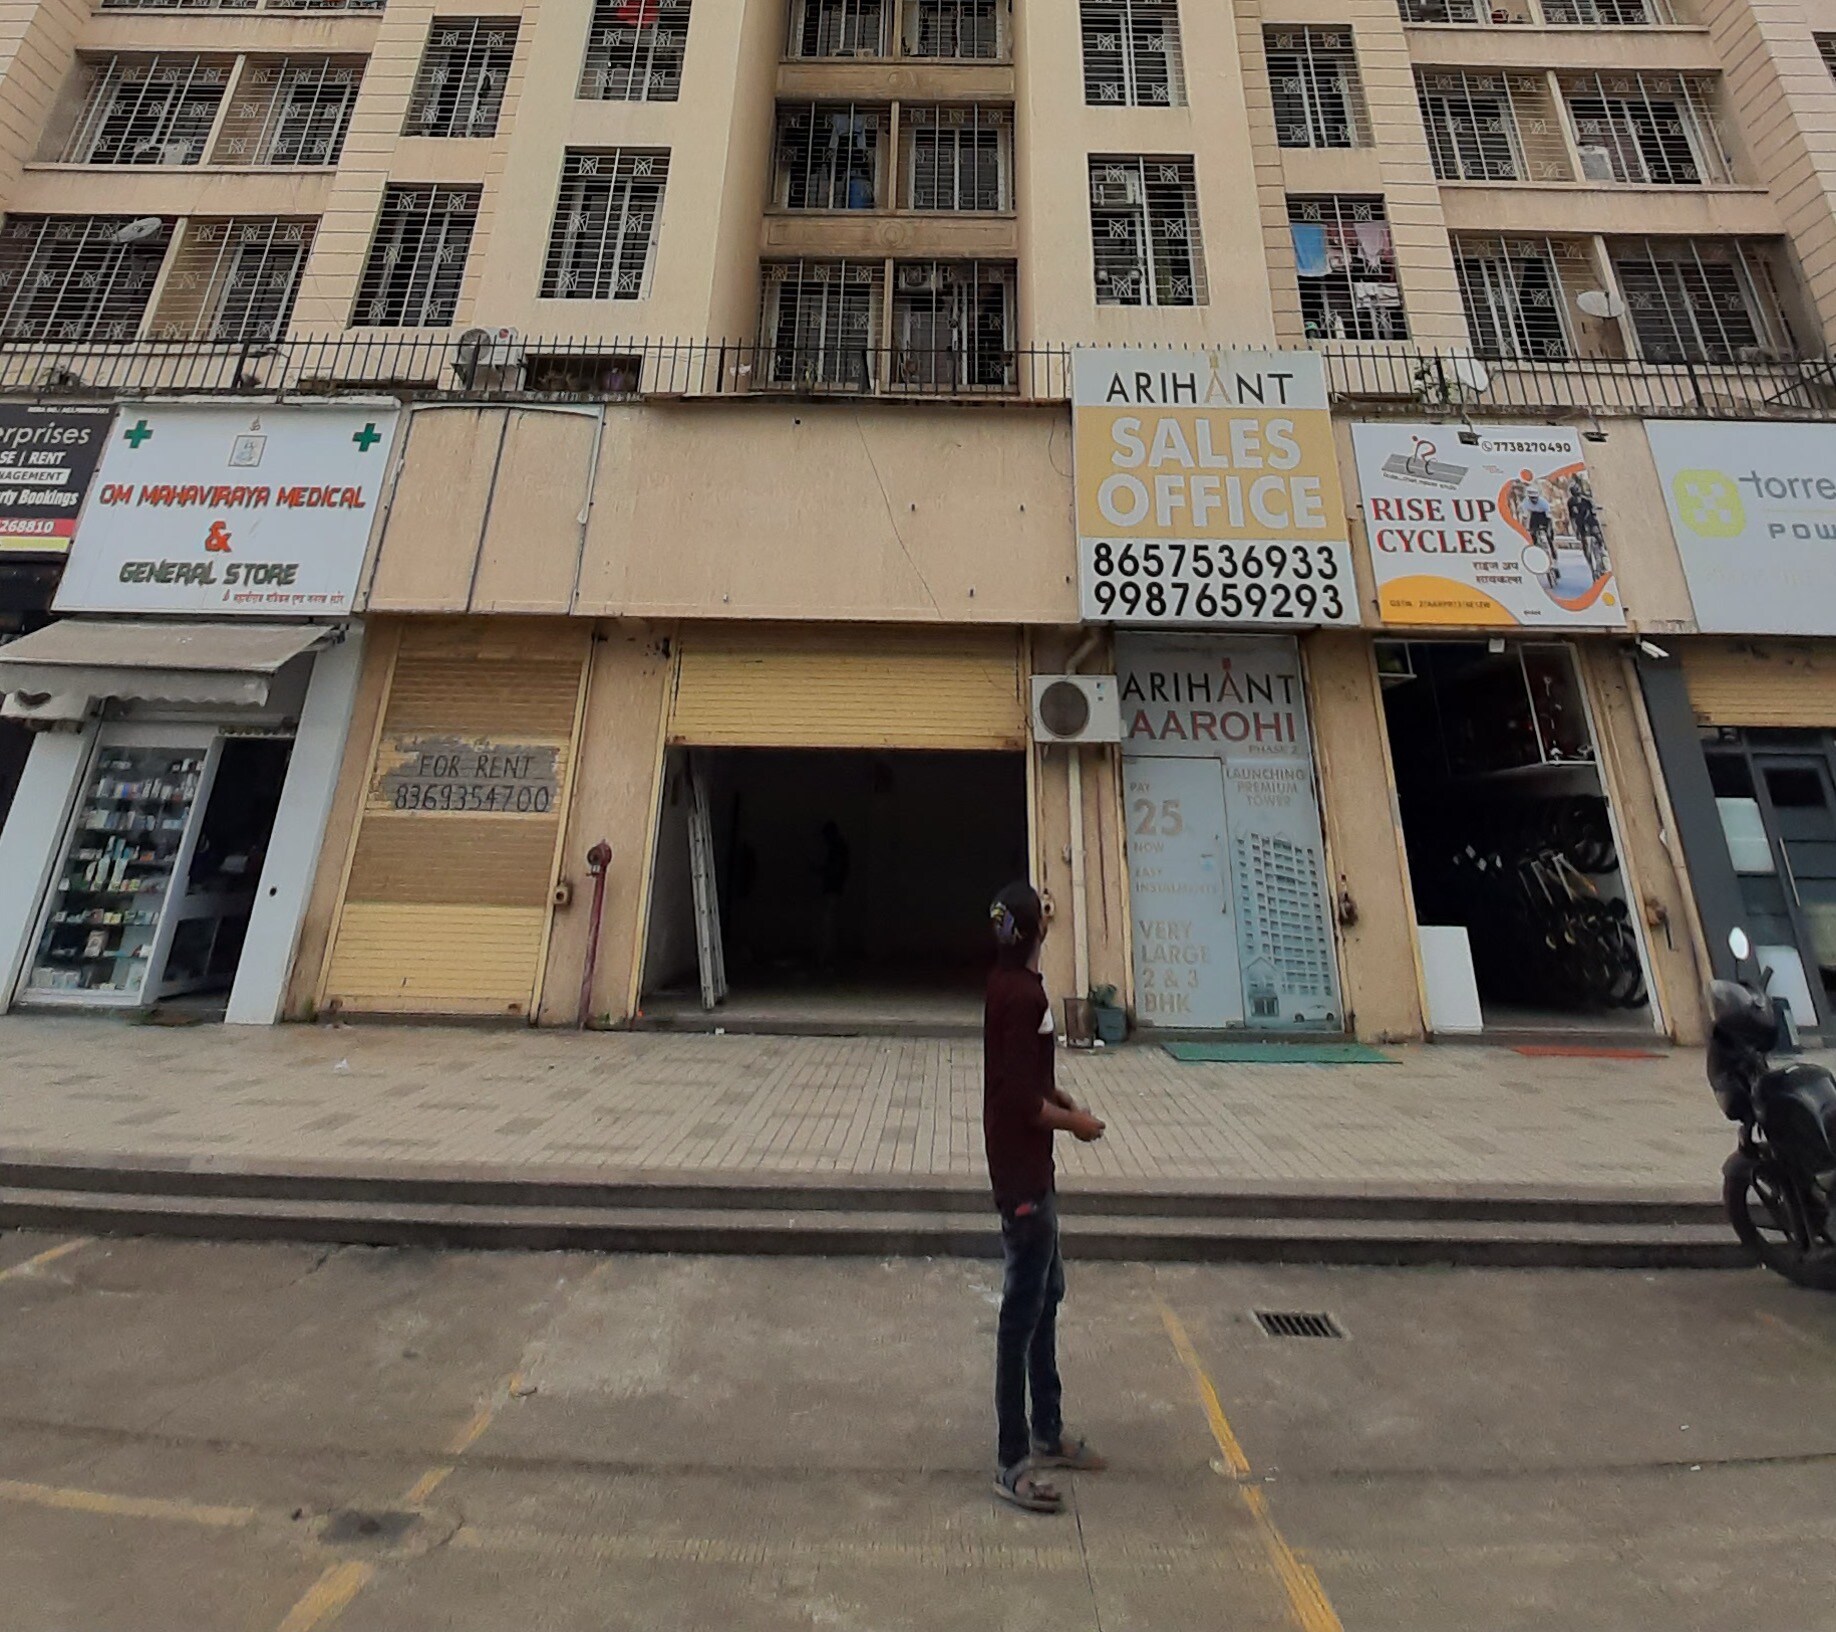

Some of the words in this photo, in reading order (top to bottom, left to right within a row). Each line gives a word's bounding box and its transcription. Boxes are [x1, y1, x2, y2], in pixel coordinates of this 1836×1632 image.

[1106, 369, 1294, 405] ARIHANT
[1110, 416, 1301, 470] SALES
[1493, 441, 1571, 453] 7738270490
[28, 451, 66, 465] RENT
[18, 488, 79, 507] Bookings
[99, 484, 135, 507] OM
[137, 484, 271, 509] MAHAVIRAYA
[276, 485, 366, 510] MEDICAL
[1738, 470, 1836, 500] torre
[1097, 472, 1327, 529] OFFICE
[1370, 497, 1445, 522] RISE
[1452, 499, 1495, 523] UP
[204, 520, 232, 553] &
[1376, 528, 1495, 554] CYCLES
[118, 559, 218, 586] GENERAL
[223, 562, 299, 587] STORE
[1093, 542, 1338, 580] 8657536933
[1094, 580, 1343, 619] 9987659293
[1122, 670, 1296, 705] ARIHANT
[1128, 708, 1296, 743] AAROHI
[418, 755, 460, 778] FOR
[475, 754, 537, 779] RENT
[1226, 768, 1306, 780] LAUNCHING
[394, 782, 549, 812] 8369354700
[1237, 782, 1298, 793] PREMIUM
[1133, 797, 1184, 837] 25
[1134, 842, 1165, 853] NOW
[1138, 919, 1192, 940] VERY
[1140, 944, 1211, 965] LARGE
[1142, 967, 1156, 989] 2
[1164, 968, 1179, 988] &
[1144, 992, 1192, 1014] BHK
